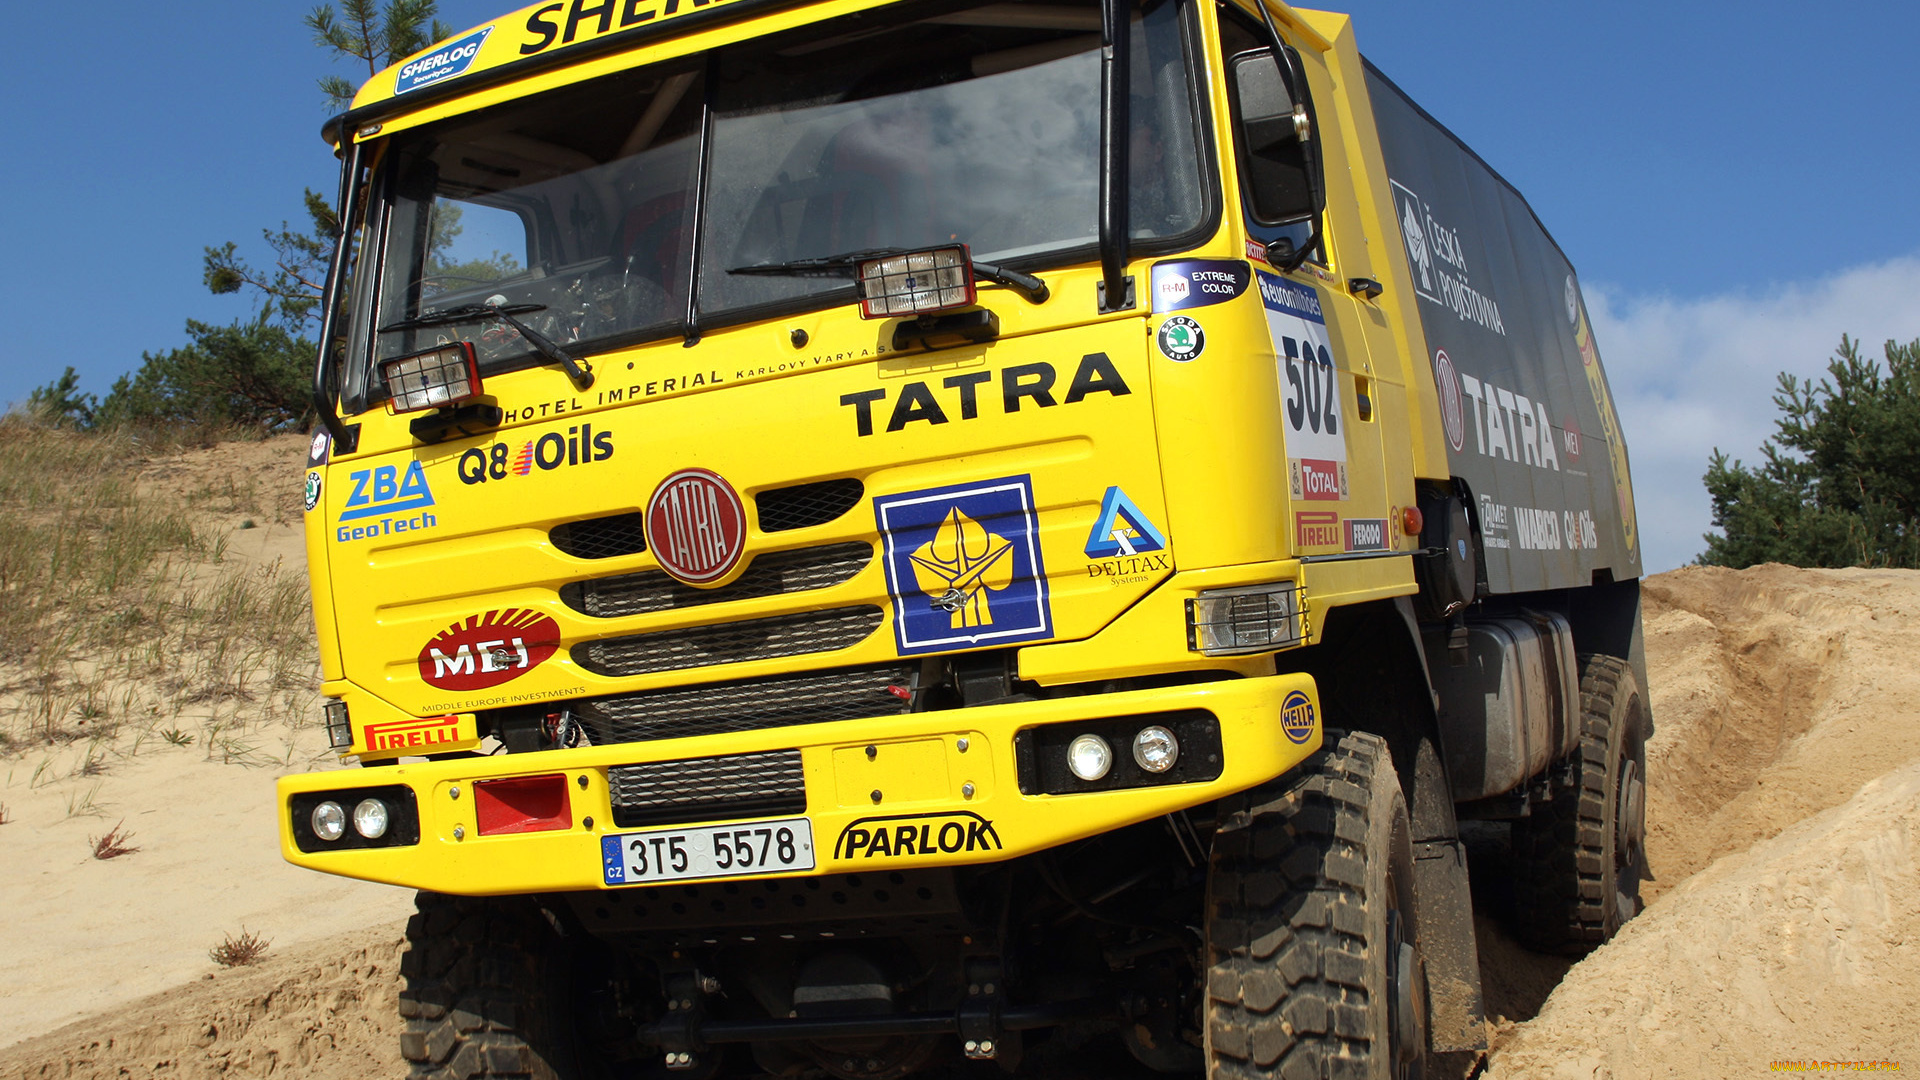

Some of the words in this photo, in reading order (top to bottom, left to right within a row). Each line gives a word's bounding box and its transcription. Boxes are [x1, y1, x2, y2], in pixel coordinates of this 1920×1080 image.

[401, 43, 477, 79] SHERLOG
[1424, 202, 1468, 273] ČESKÁ
[1162, 283, 1186, 292] R-M
[1192, 272, 1237, 284] EXTREME
[1202, 284, 1235, 295] COLOR
[1169, 351, 1195, 360] AUTO
[504, 397, 583, 424] HOTEL
[598, 371, 724, 405] IMPERIAL
[736, 360, 807, 379] KARLOVY
[813, 351, 854, 365] VARY
[839, 352, 1132, 438] TATRA
[1282, 336, 1337, 435] 502
[1461, 373, 1560, 472] TATRA
[458, 443, 509, 485] Q8
[534, 424, 614, 470] Oils
[1563, 430, 1580, 456] MEI
[345, 460, 436, 508] ZBA
[1303, 466, 1338, 494] TOTAL
[337, 512, 437, 543] GeoTech
[659, 480, 728, 571] TATRA
[1296, 512, 1338, 546] PIRELLI
[1353, 523, 1381, 545] FERODO
[1513, 507, 1561, 550] WABCO
[1579, 509, 1597, 549] Oils
[1087, 554, 1170, 578] DELTAX
[1110, 574, 1149, 587] Systems
[429, 637, 530, 679] MEI
[422, 701, 462, 713] MIDDLE
[465, 696, 508, 708] EUROPE
[510, 686, 586, 703] INVESTMENTS
[1284, 704, 1314, 727] HELLA
[364, 715, 459, 752] PIRELLI
[629, 835, 688, 875] 3T5
[714, 827, 796, 869] 5578
[845, 819, 993, 859] PARLOK
[607, 866, 623, 879] CZ
